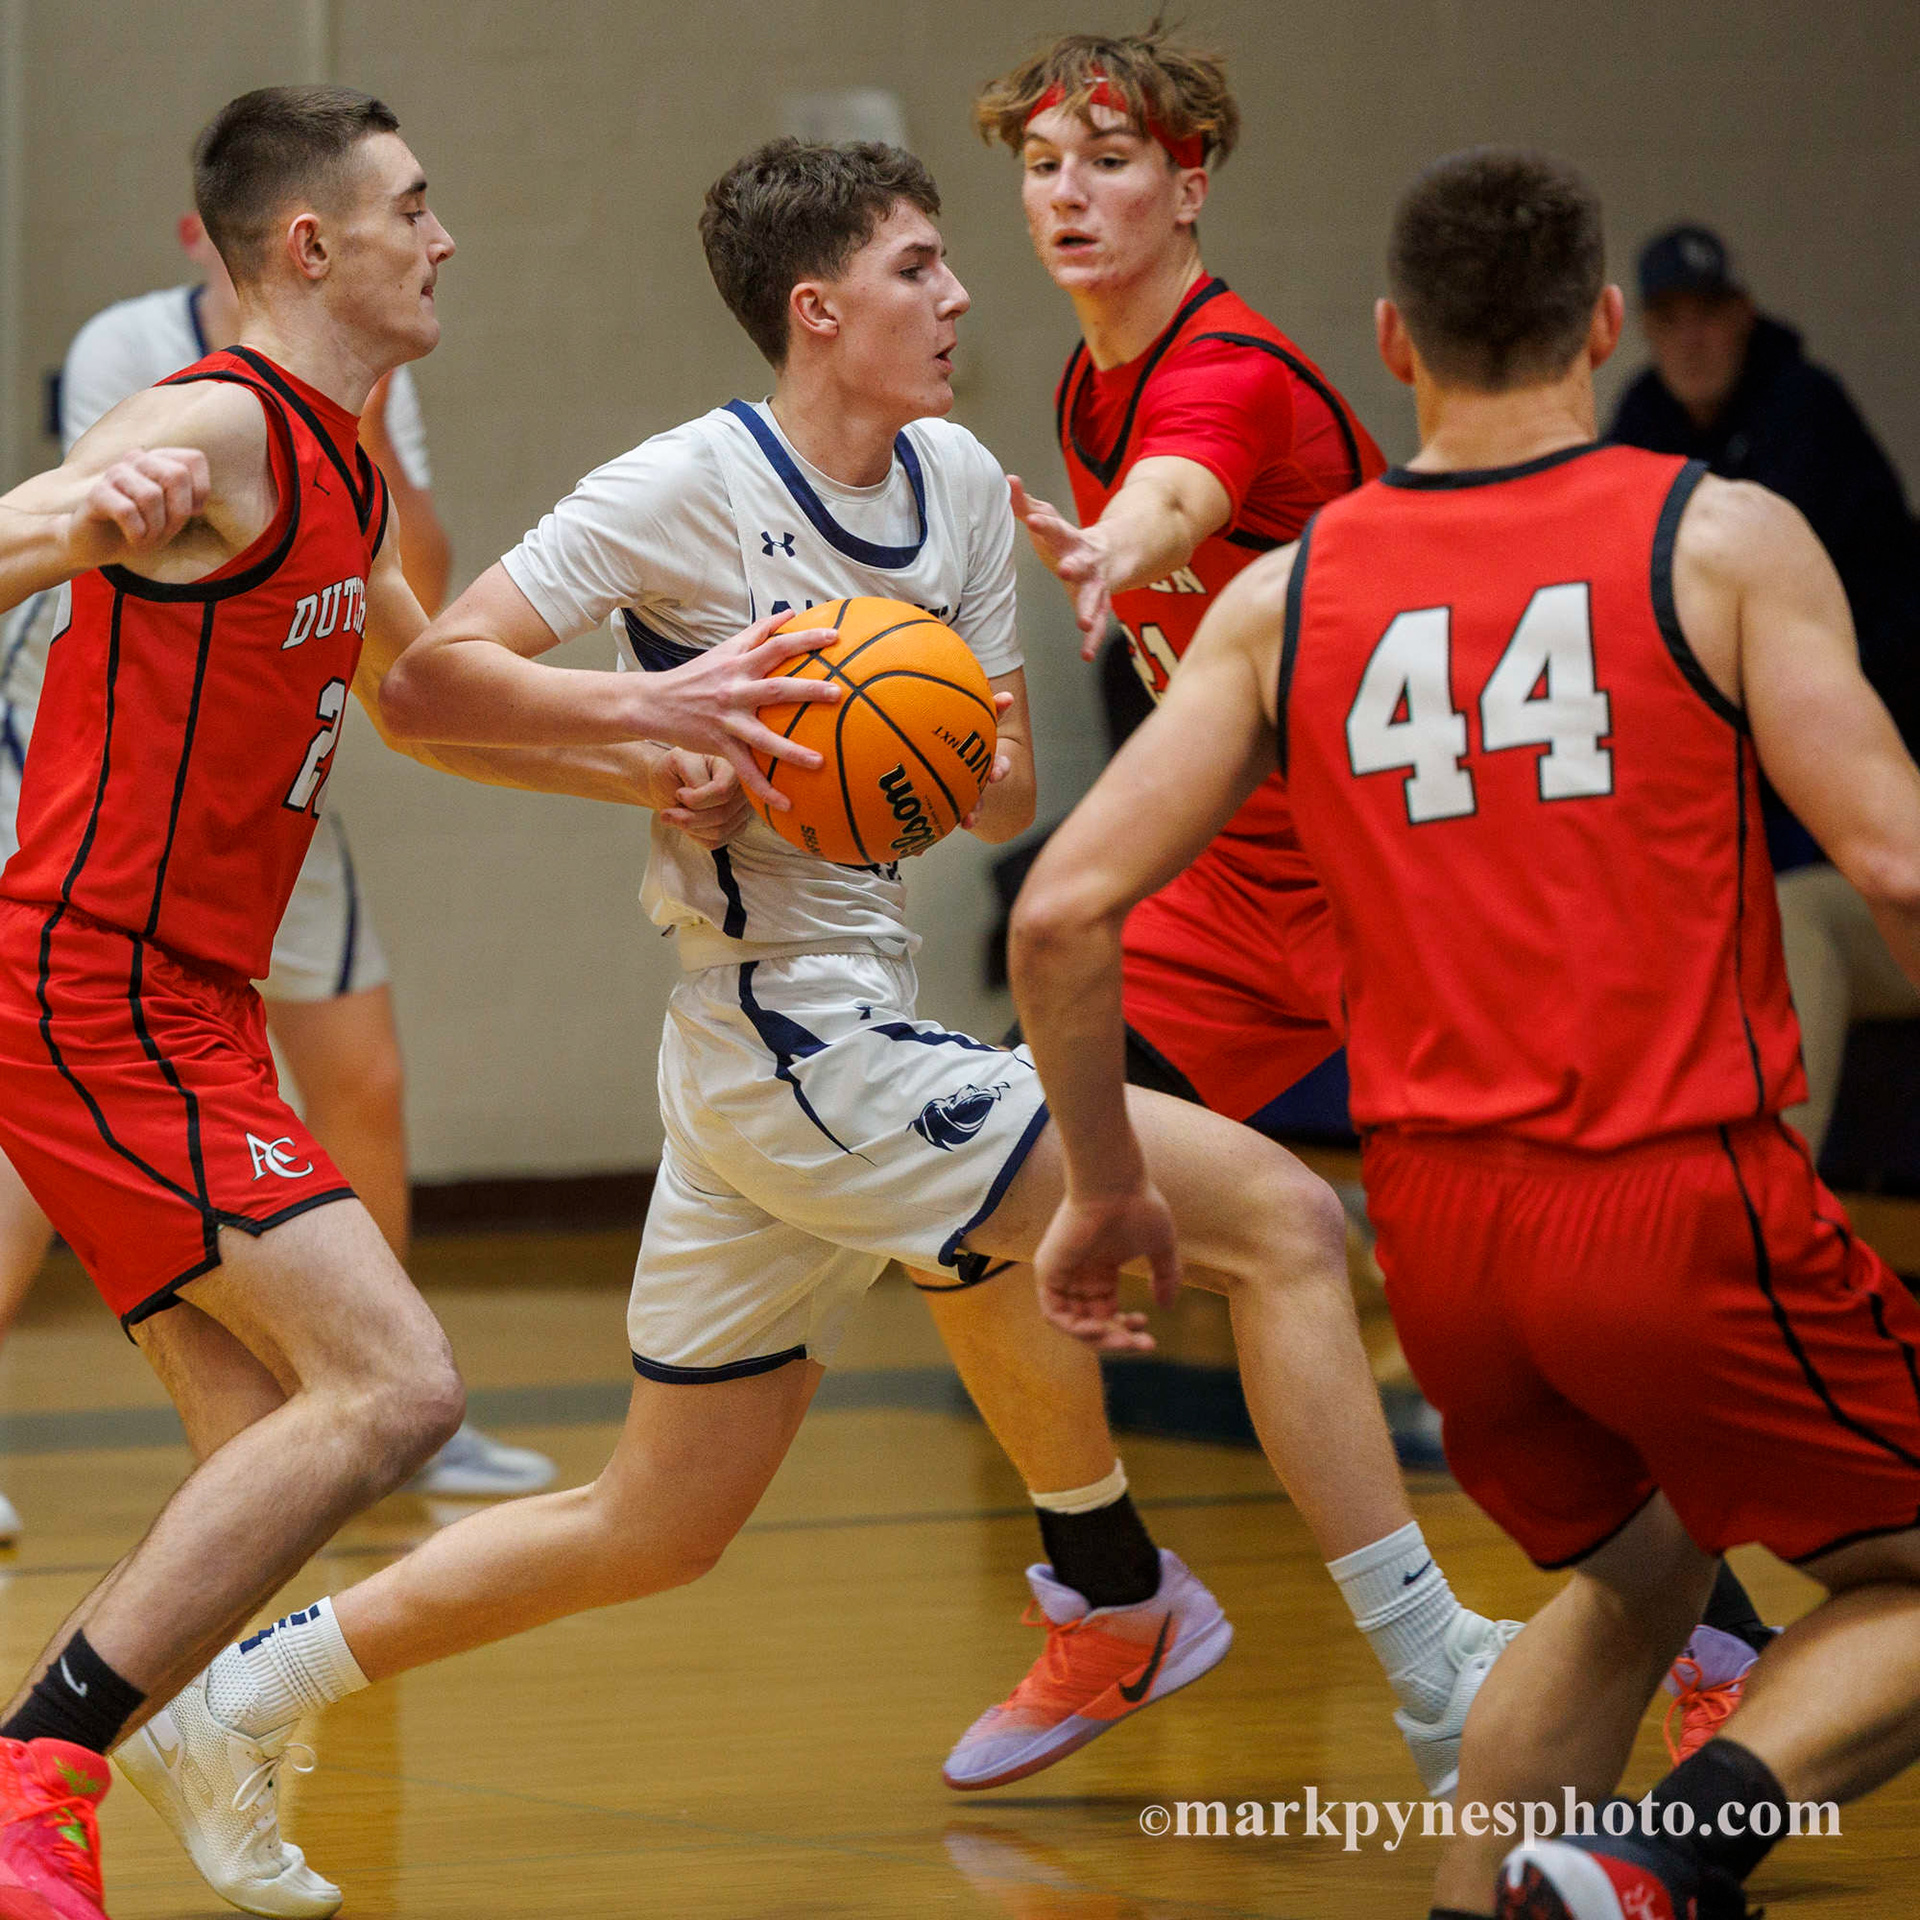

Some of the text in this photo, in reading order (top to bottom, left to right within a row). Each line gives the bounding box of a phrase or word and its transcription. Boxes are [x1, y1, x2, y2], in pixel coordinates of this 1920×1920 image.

[282, 676, 346, 819] 2
[932, 726, 959, 749] NXT
[1345, 581, 1614, 825] 44
